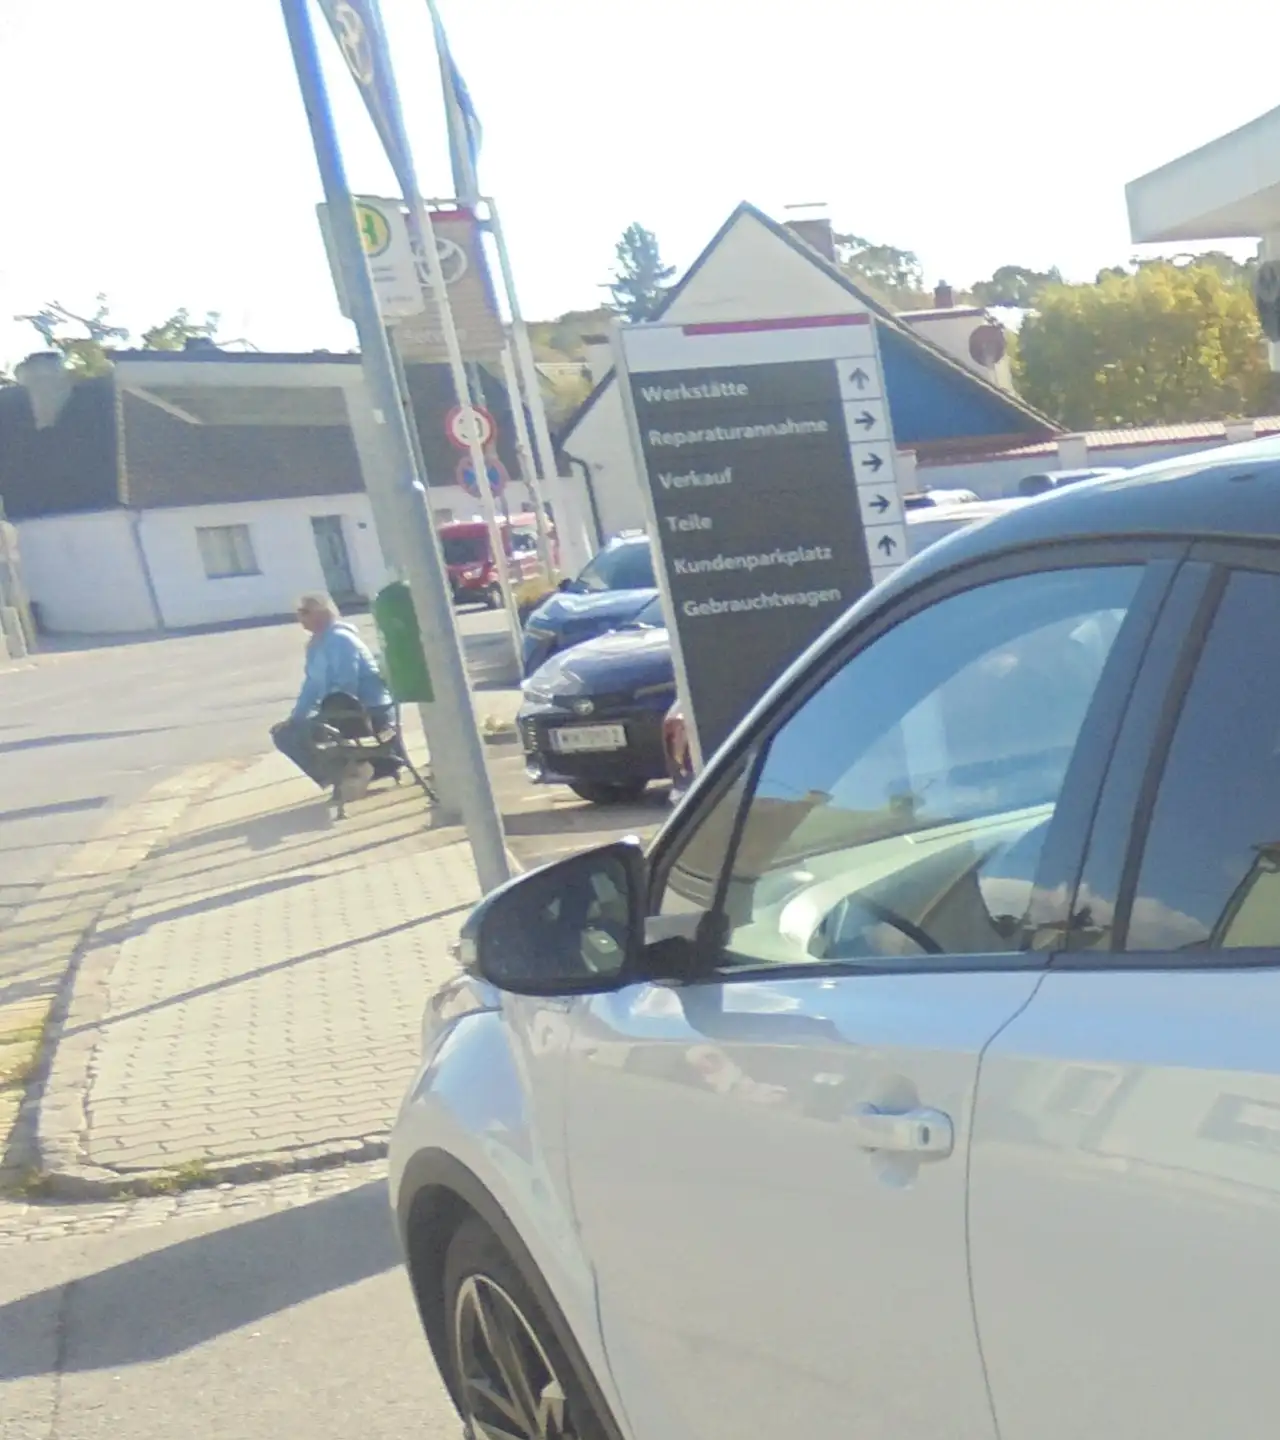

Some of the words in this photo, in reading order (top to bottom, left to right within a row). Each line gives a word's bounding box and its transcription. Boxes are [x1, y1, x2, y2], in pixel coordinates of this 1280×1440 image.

[641, 380, 749, 403] Werkstätte
[650, 416, 829, 448] Reparaturannahme
[658, 467, 734, 490] Verkauf
[665, 513, 713, 532] Teile
[673, 546, 833, 575] Kundenparkplatz
[683, 588, 842, 617] Gebrauchtwagen
